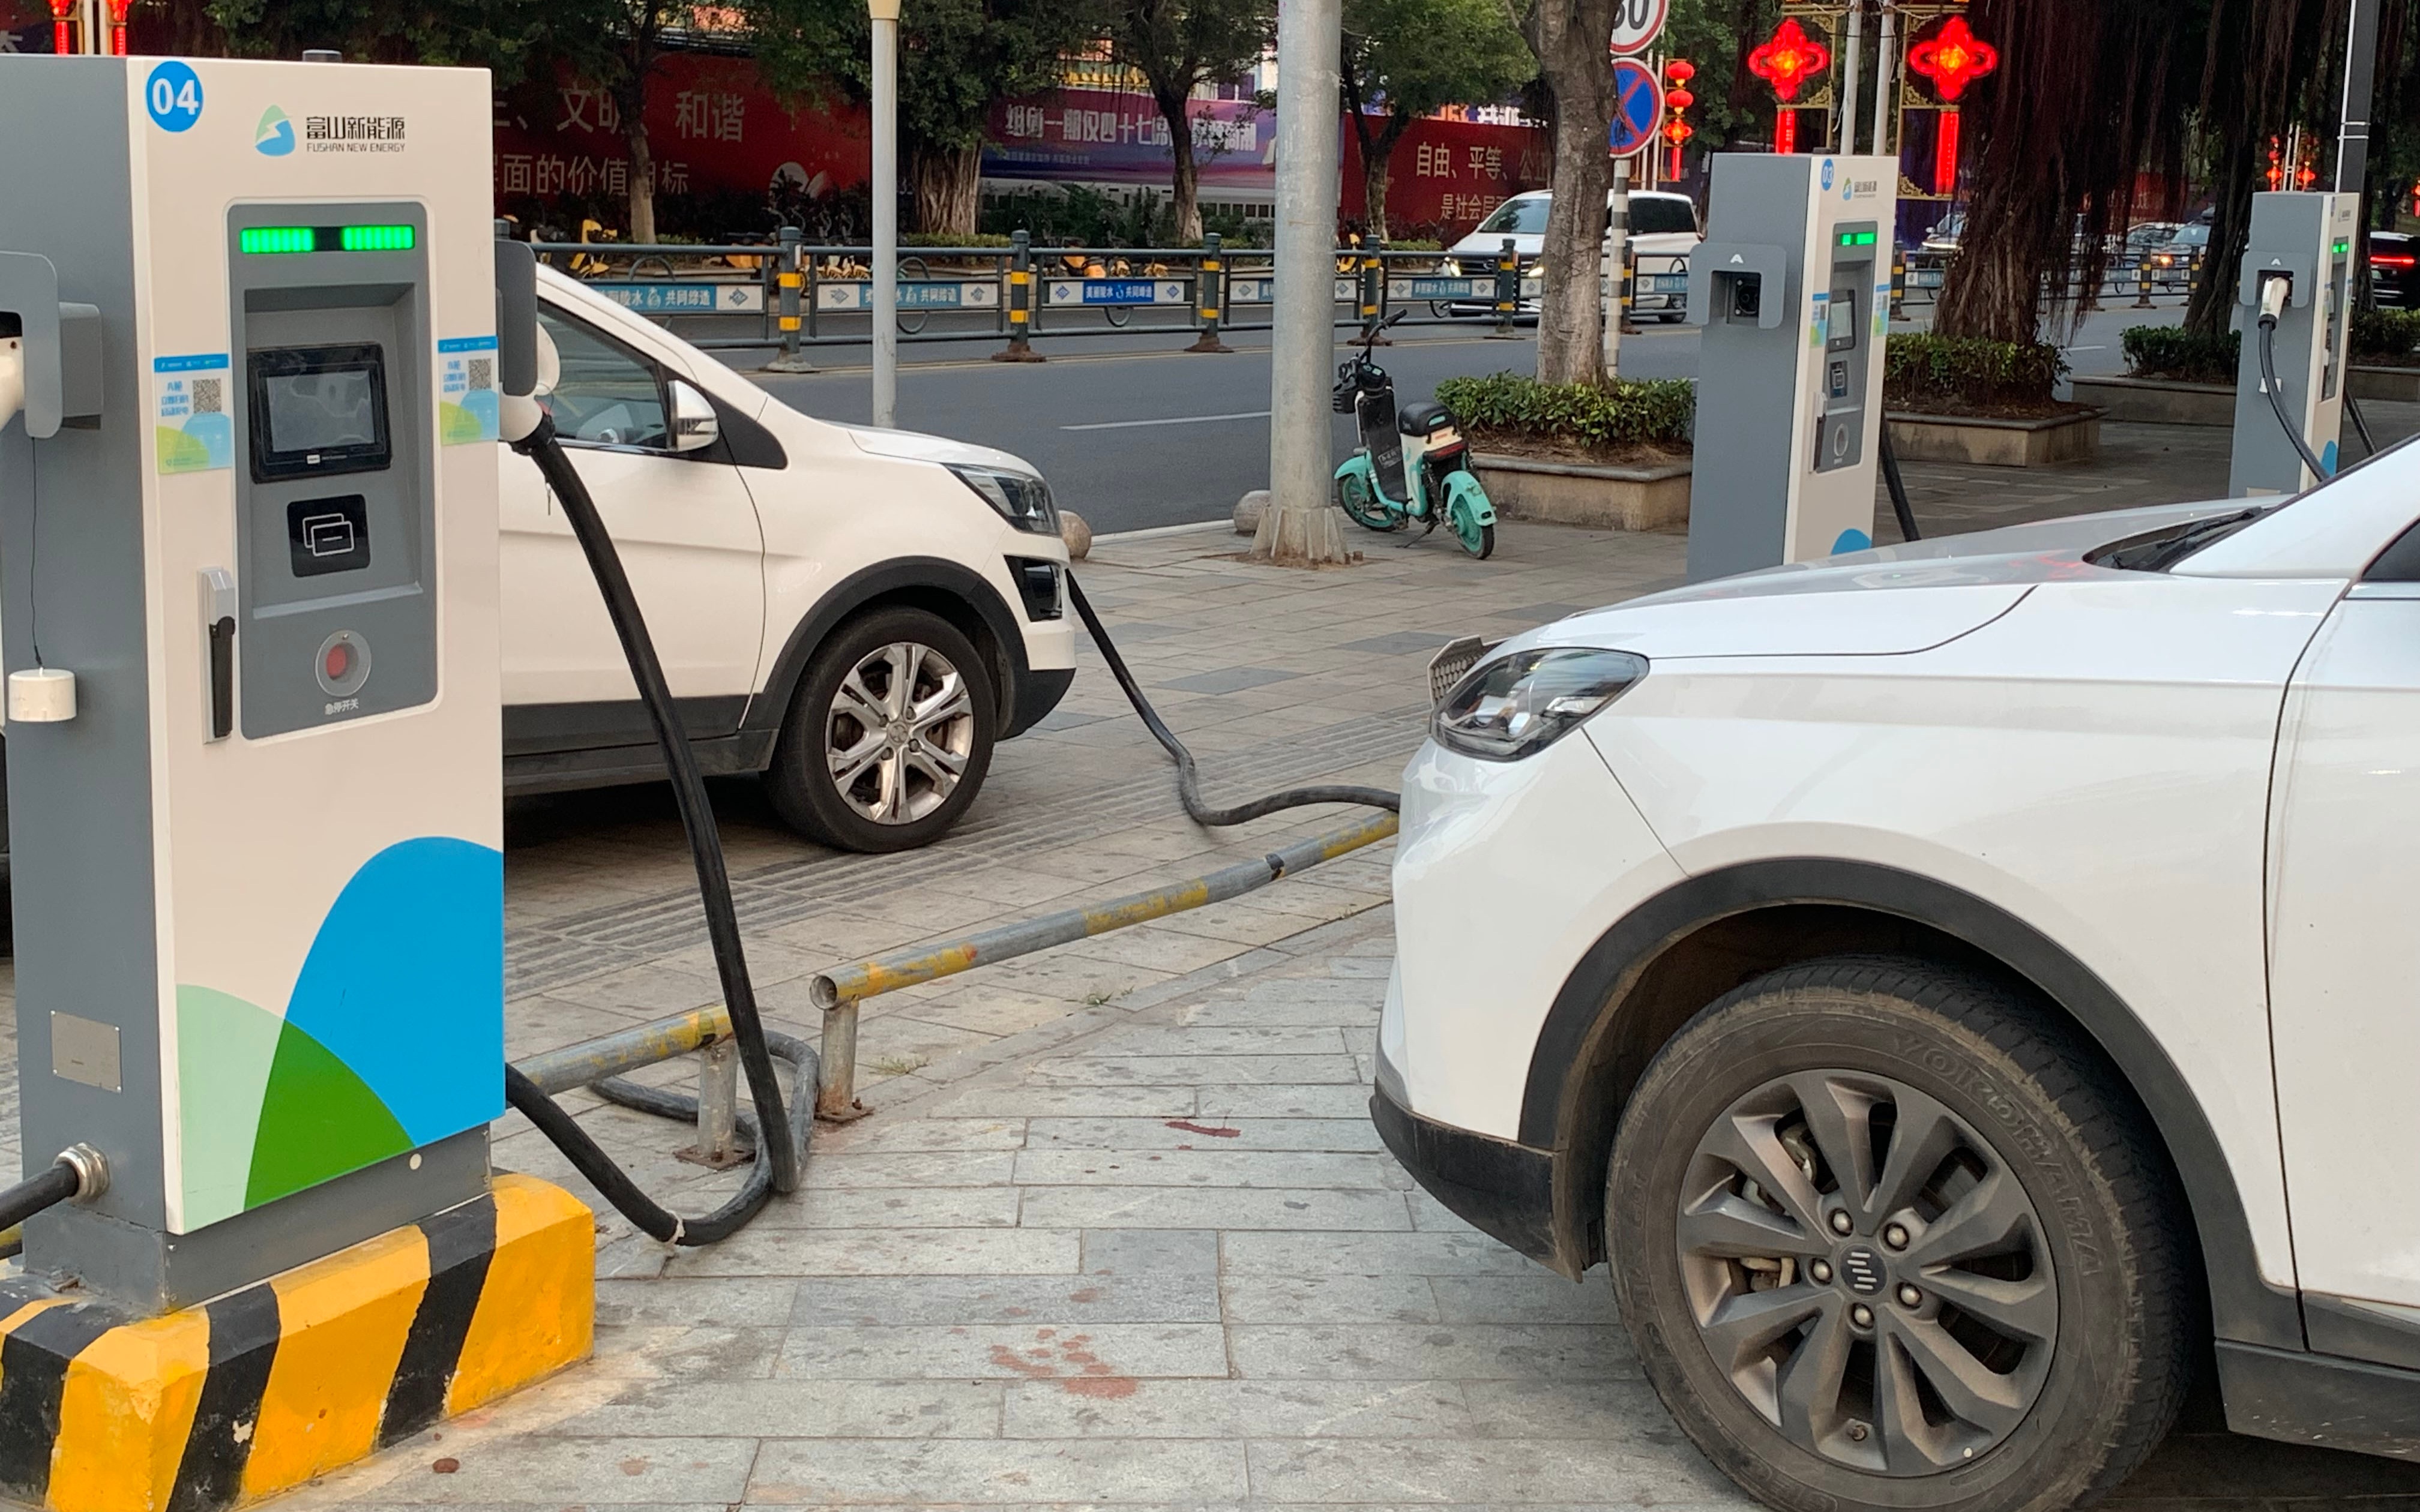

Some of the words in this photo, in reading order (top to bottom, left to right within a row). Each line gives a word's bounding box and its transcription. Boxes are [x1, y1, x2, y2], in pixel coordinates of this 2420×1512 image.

[152, 77, 199, 115] 04
[307, 116, 405, 140] 富山新能源
[307, 143, 344, 152] FUSHAN
[347, 143, 367, 152] NEW
[370, 143, 405, 152] ENERGY
[1822, 166, 1833, 184] 03
[1441, 193, 1508, 221] 是社会层
[1730, 254, 1744, 263] A
[325, 698, 359, 715] 急停开关
[1895, 1036, 2104, 1276] YOKOHAMA
